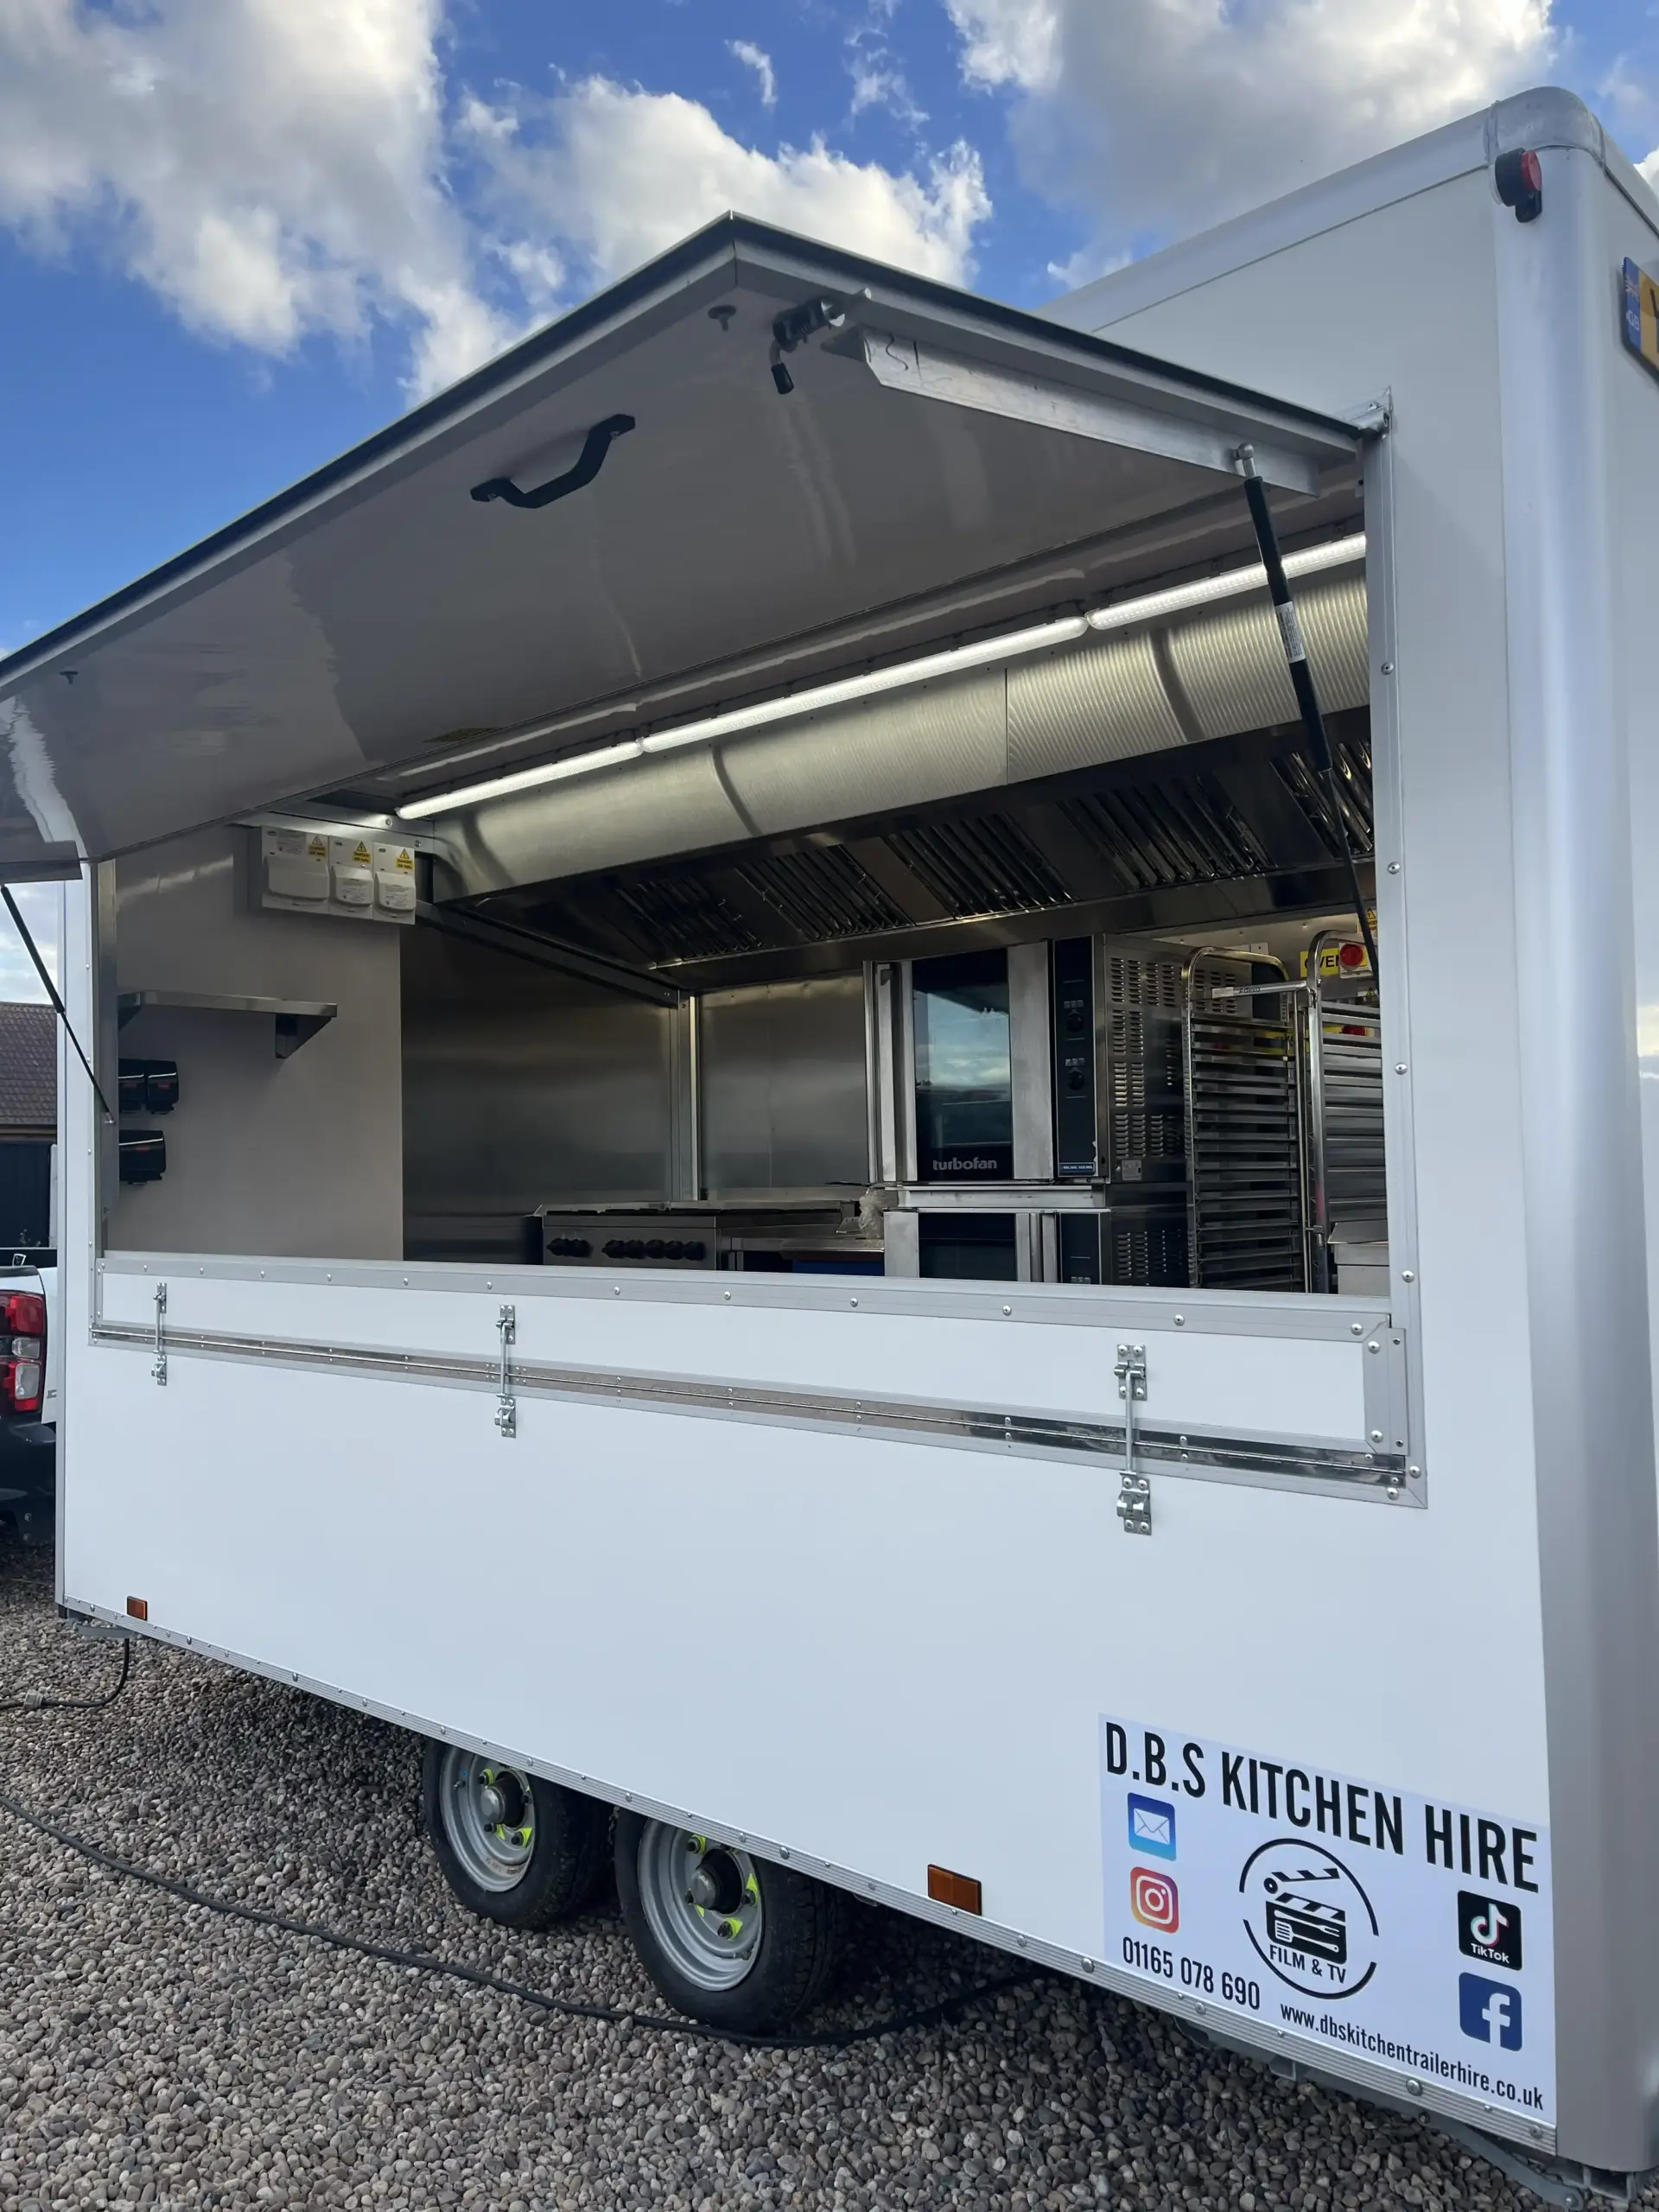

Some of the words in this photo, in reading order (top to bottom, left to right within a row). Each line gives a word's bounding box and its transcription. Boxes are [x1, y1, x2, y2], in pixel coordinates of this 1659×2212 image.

[933, 1157, 997, 1171] turbofan
[1106, 1721, 1206, 1798] D.B.S
[1221, 1751, 1404, 1855] KITCHEN
[1425, 1804, 1539, 1894] HIRE
[1122, 1936, 1173, 1979] 01165
[1180, 1956, 1214, 1993] 078
[1221, 1972, 1260, 2011] 690
[1269, 1944, 1306, 1971] FILM
[1311, 1958, 1323, 1977] &
[1326, 1963, 1347, 1985] TV
[1471, 1942, 1510, 1965] TikTok
[1280, 2003, 1544, 2111] www.dbskitchentrailerhire.co.uk
